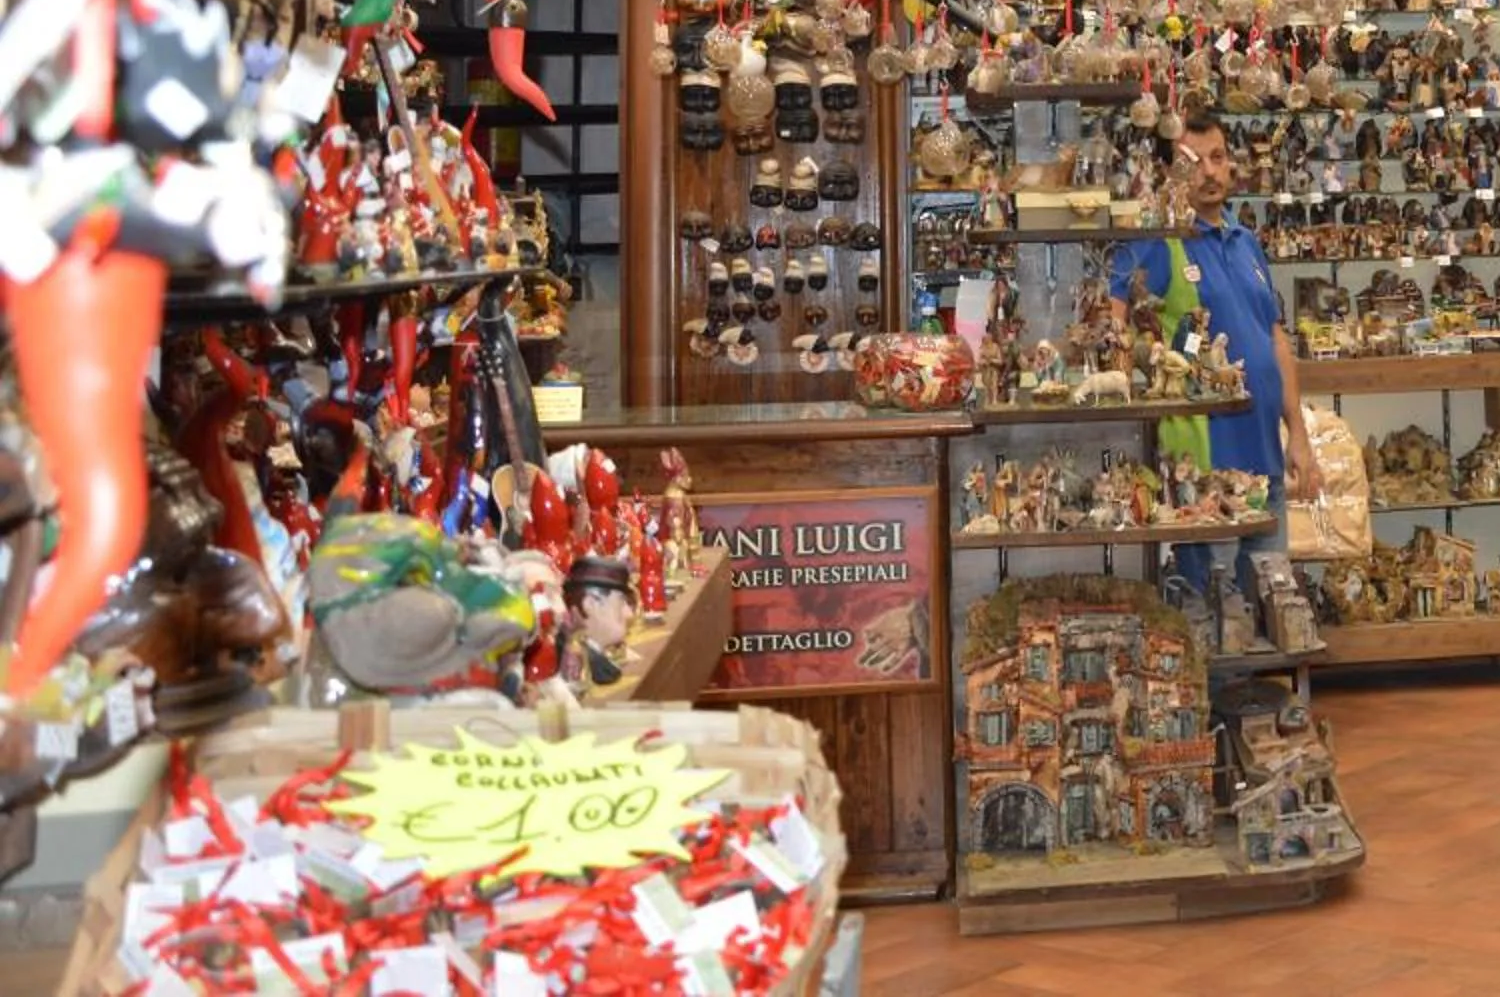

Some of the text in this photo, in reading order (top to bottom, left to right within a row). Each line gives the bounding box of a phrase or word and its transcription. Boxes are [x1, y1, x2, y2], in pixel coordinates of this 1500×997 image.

[796, 522, 904, 554] LUIGI
[791, 563, 908, 585] PRESEPIALI
[724, 631, 852, 652] DETTAGLIO
